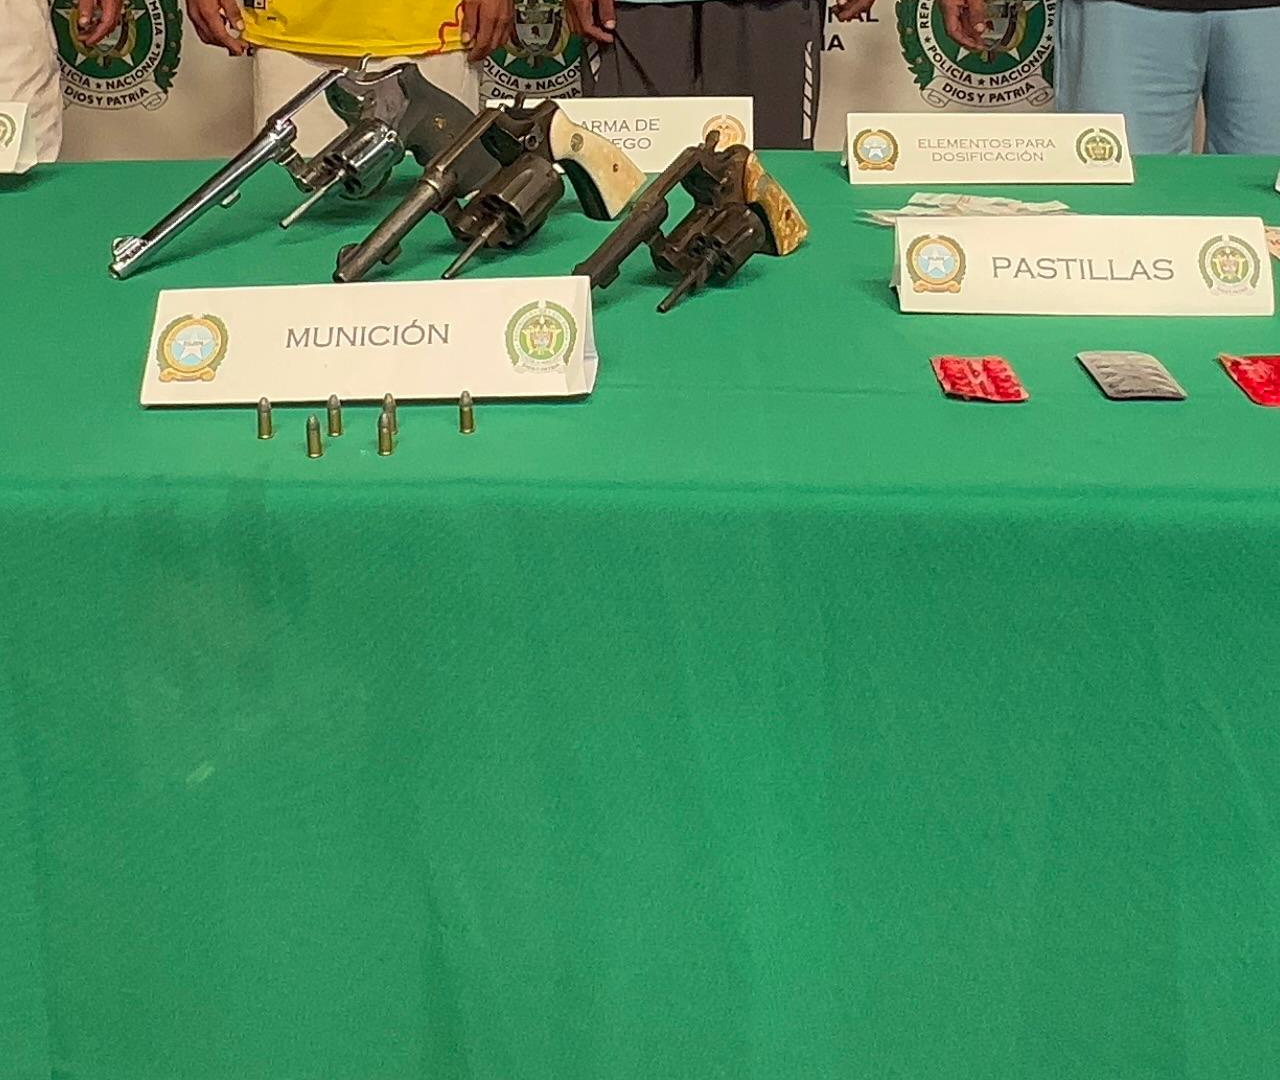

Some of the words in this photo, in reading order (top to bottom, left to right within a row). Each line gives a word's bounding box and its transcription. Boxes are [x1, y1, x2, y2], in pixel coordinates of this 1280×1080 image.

[106, 50, 161, 89] NACIONAL
[990, 43, 1051, 85] NACIONAL
[64, 87, 93, 104] DIOS
[107, 88, 149, 105] PATRIA
[942, 83, 973, 101] DIOS
[989, 83, 1035, 102] PATRIA
[635, 119, 660, 131] DE
[612, 138, 651, 149] EGO
[919, 138, 1011, 149] ELEMENTOS
[1015, 138, 1056, 149] PARA
[932, 150, 1043, 162] DOSIFICACIÓN
[992, 256, 1174, 281] PASTILLAS
[286, 319, 450, 349] MUNICIÓN
